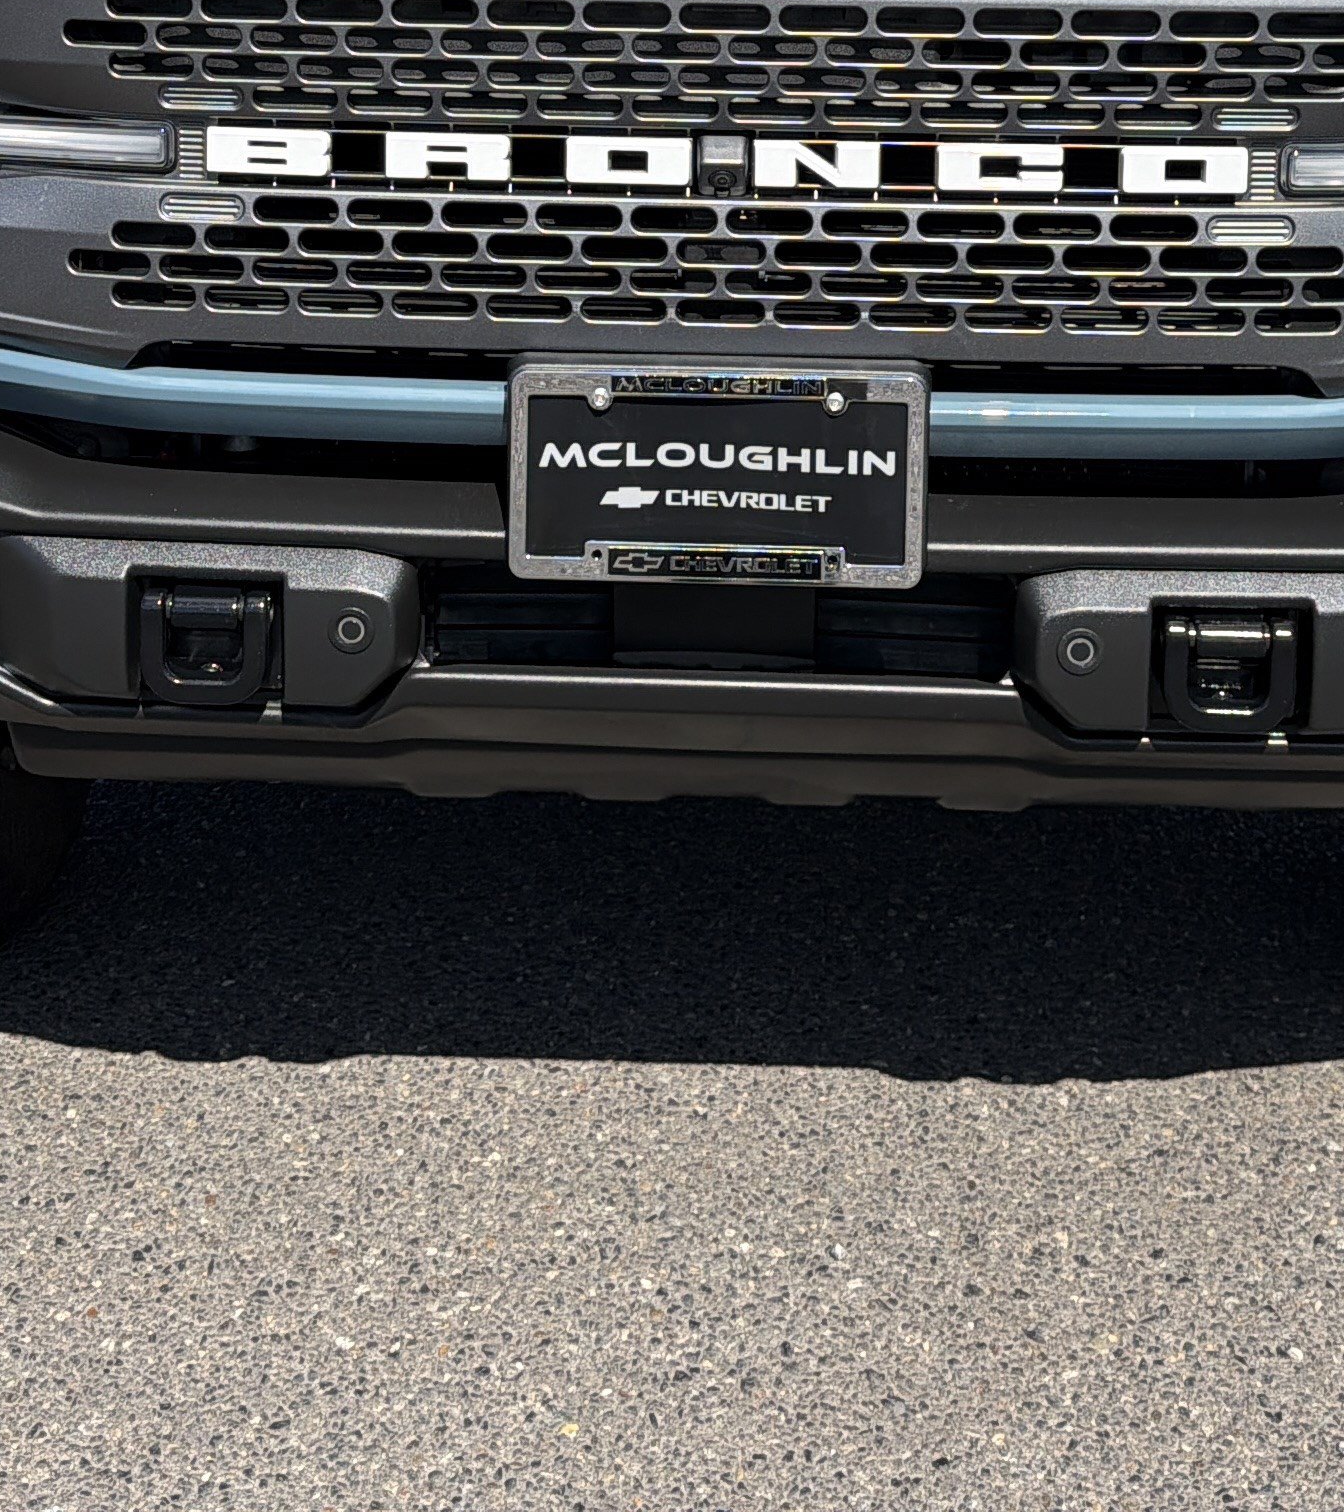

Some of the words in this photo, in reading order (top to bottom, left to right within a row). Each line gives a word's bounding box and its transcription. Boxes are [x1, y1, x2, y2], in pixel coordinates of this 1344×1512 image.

[205, 125, 1250, 196] BRONCO
[615, 375, 823, 396] MCLOUGHLIN
[538, 441, 897, 477] MCLOUGHLIN
[664, 488, 833, 514] CHEVROLET
[668, 556, 817, 576] CHEVROLET
